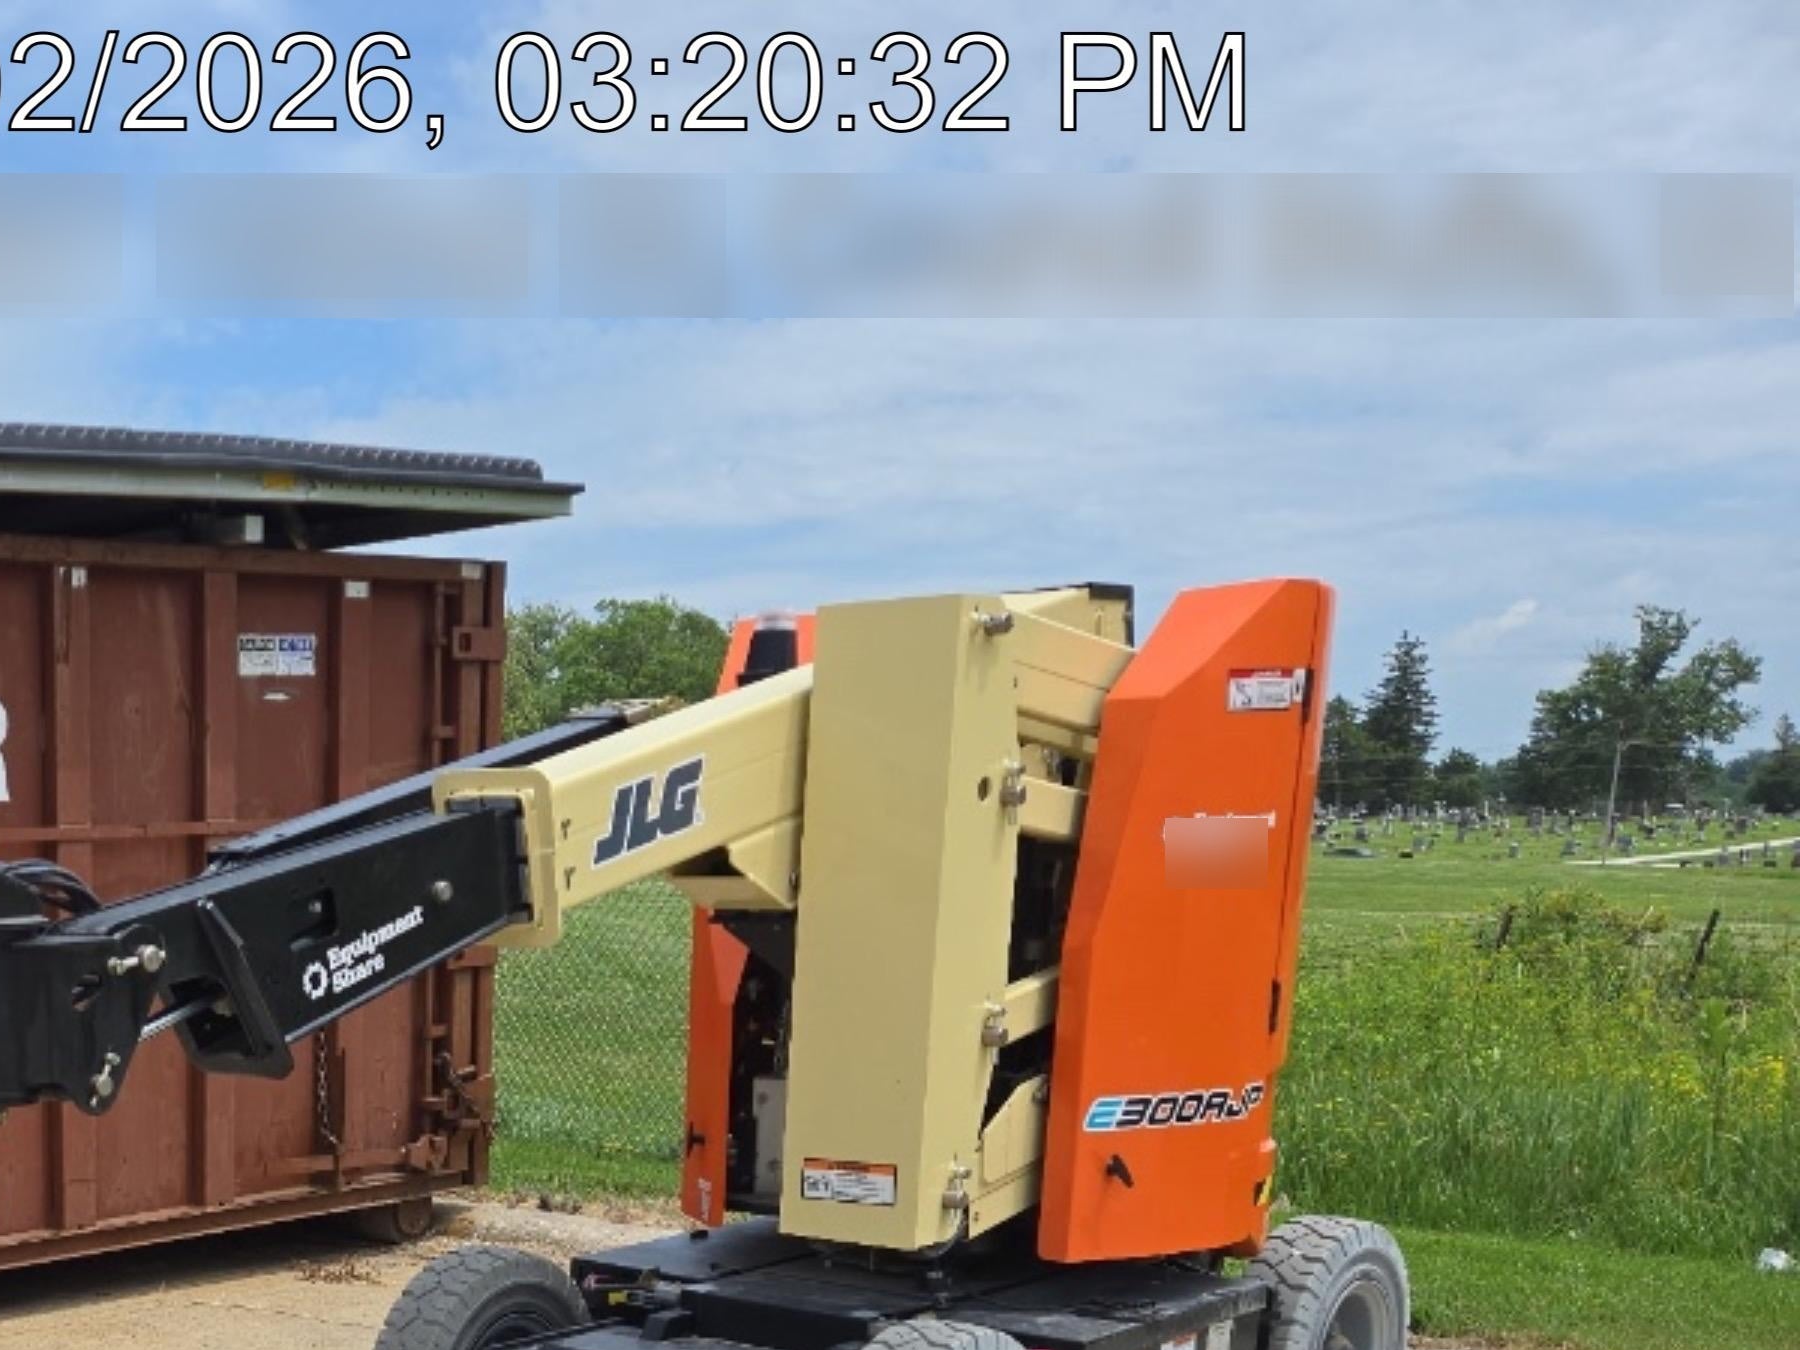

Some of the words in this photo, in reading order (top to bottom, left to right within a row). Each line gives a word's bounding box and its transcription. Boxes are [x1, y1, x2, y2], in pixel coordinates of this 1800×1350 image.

[591, 752, 704, 870] JLG
[327, 905, 425, 971] Equipment
[332, 953, 386, 994] Share
[1084, 1081, 1263, 1132] E300AJP
